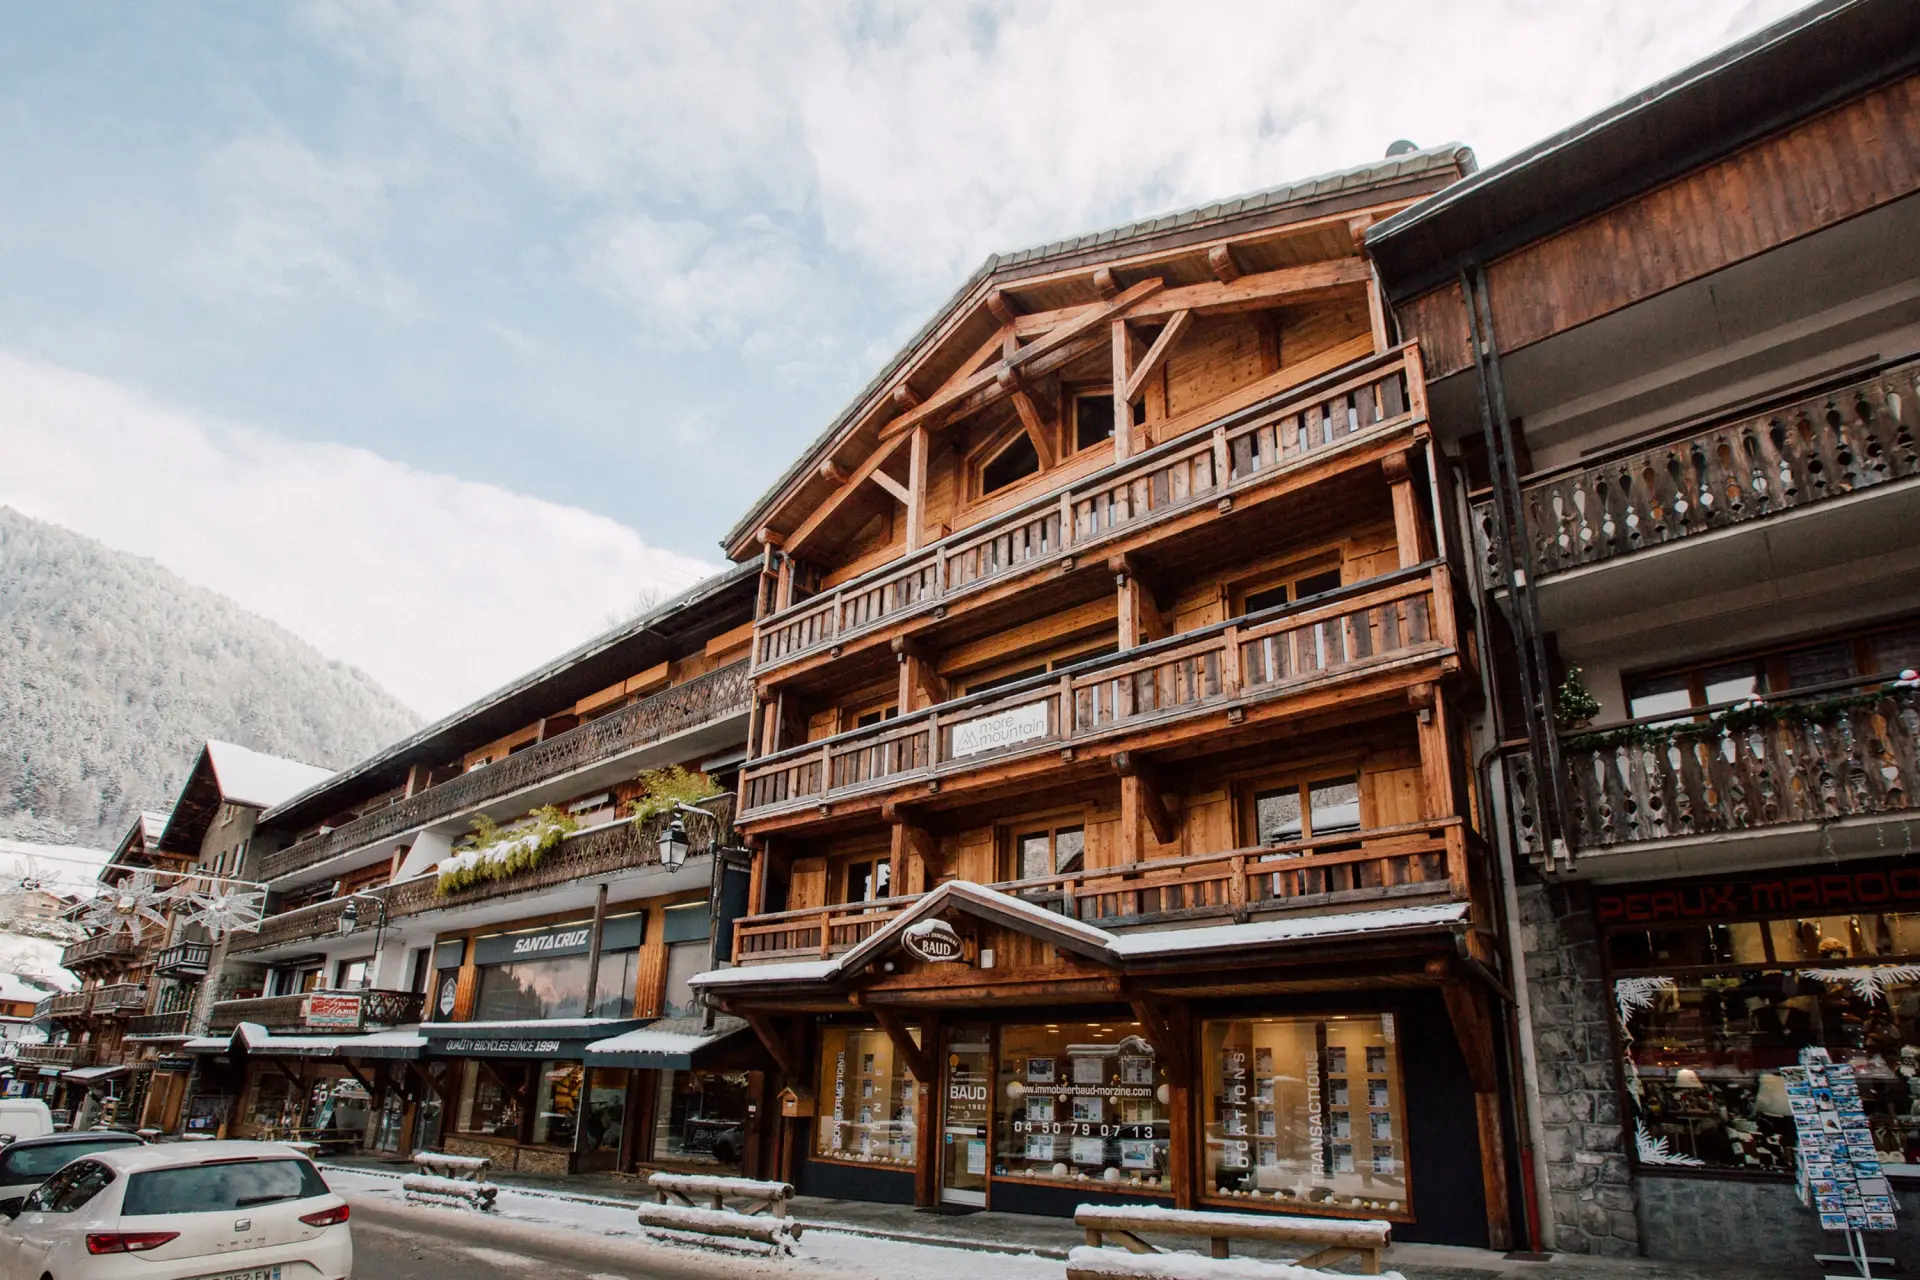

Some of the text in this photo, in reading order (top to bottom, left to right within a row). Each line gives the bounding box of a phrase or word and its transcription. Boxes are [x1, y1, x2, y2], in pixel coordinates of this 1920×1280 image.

[980, 716, 1014, 734] more
[980, 718, 1044, 747] mountain
[513, 929, 590, 953] SANTA CRUZ
[922, 940, 951, 955] BAUD
[446, 1039, 560, 1052] QUALITY BICYCLES SINCE 1994
[832, 1052, 845, 1148] CONSTRUCTIONS
[950, 1086, 987, 1100] BAUD
[1234, 1052, 1249, 1182] LOCATIONS
[1306, 1051, 1325, 1186] TRANSACTIONS
[1014, 1121, 1153, 1138] 04 50 79 07 13
